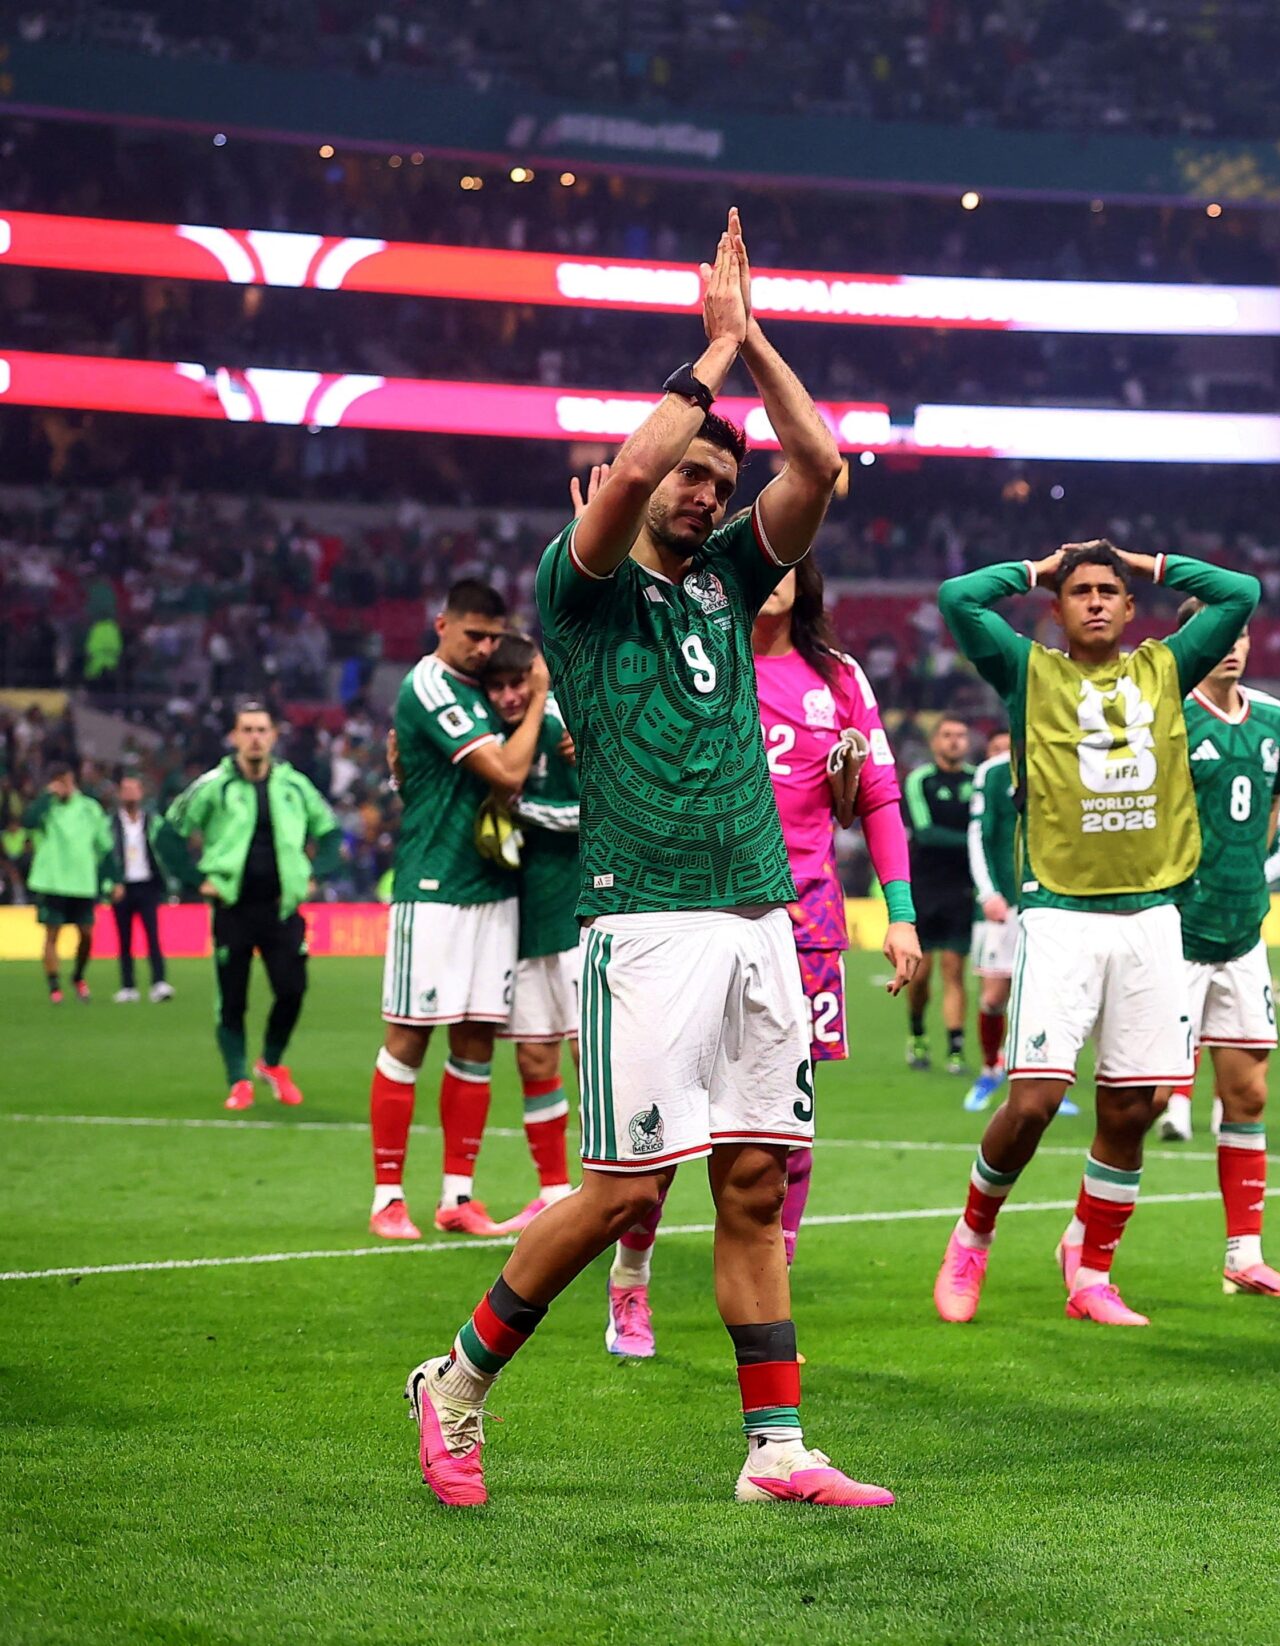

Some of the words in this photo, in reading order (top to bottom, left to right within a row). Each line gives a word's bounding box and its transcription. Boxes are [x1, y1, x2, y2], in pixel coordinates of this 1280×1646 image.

[681, 634, 716, 693] 9
[761, 723, 796, 776] 2
[1104, 765, 1140, 780] FIFA
[1081, 796, 1135, 811] WORLD
[1135, 794, 1158, 809] CUP
[1230, 775, 1251, 821] 8
[1081, 809, 1157, 833] 2026
